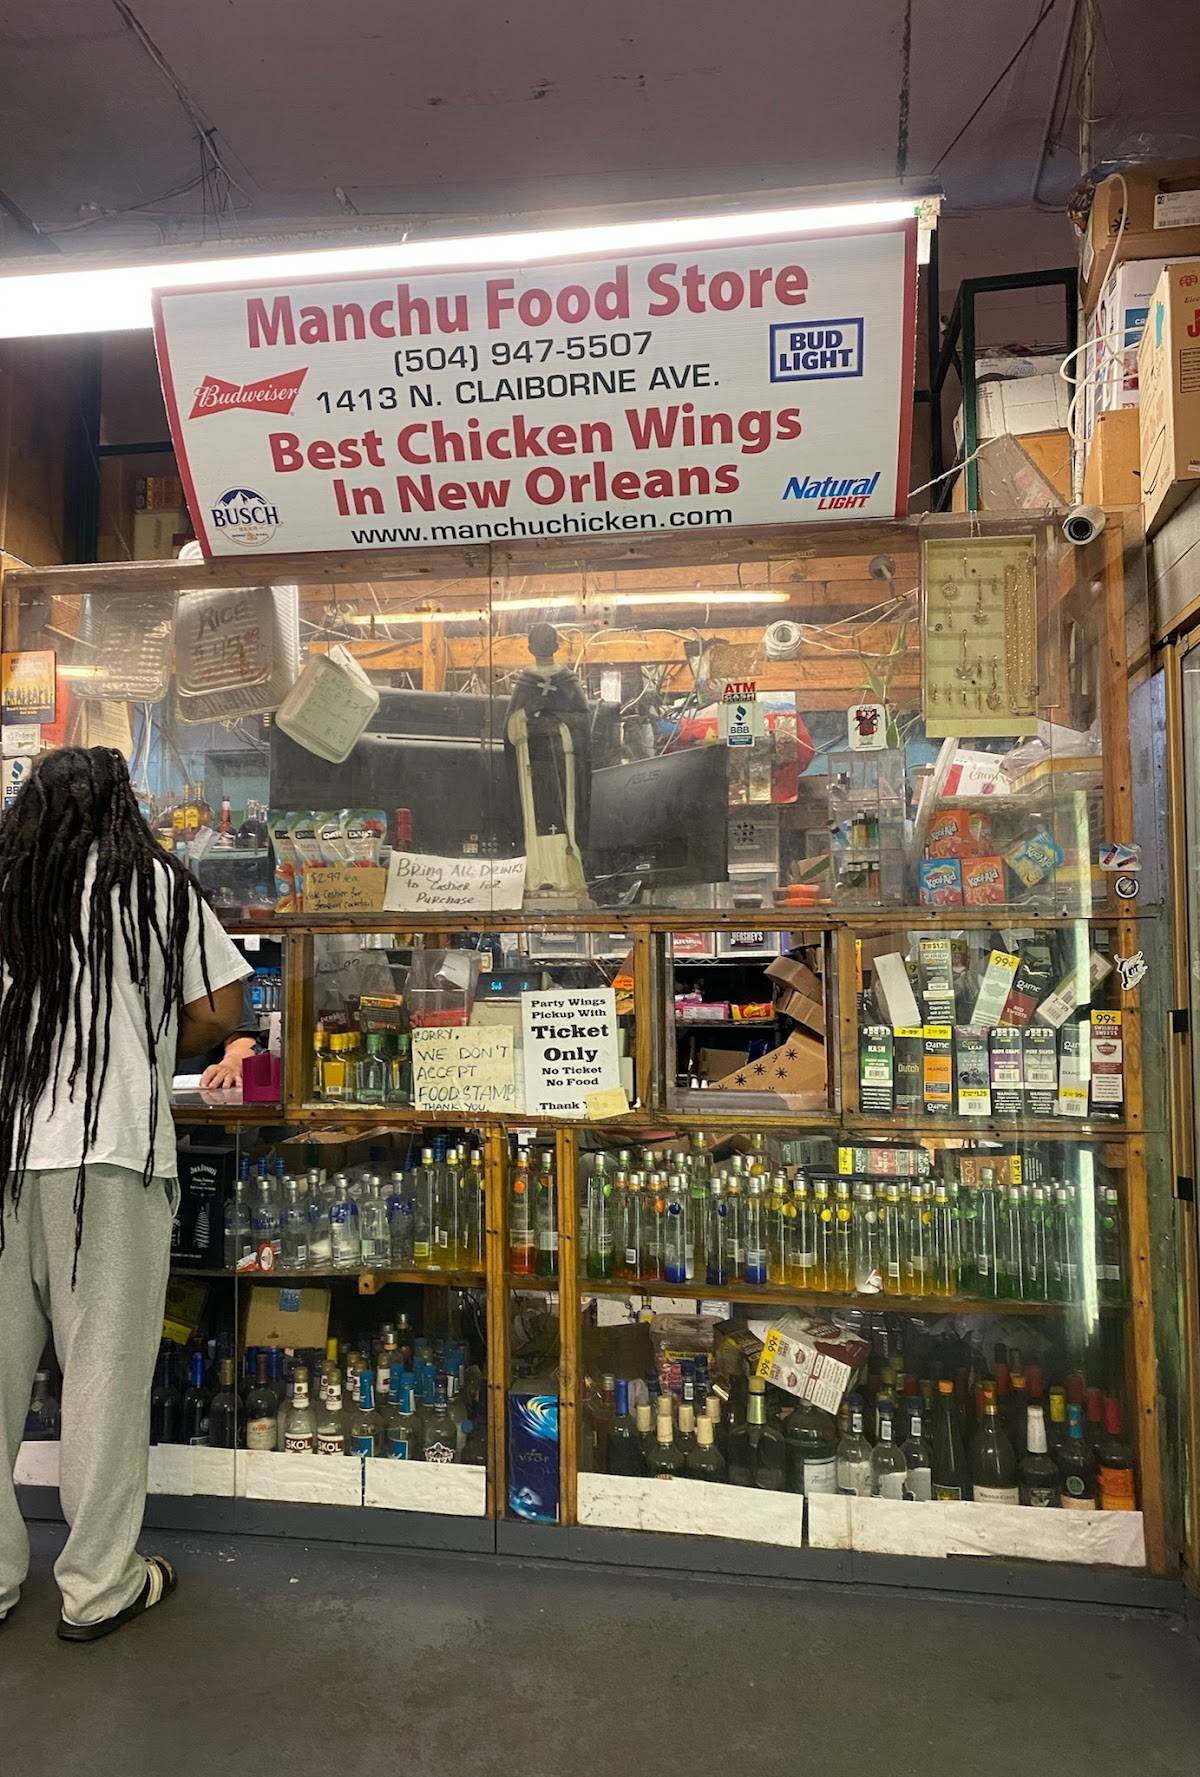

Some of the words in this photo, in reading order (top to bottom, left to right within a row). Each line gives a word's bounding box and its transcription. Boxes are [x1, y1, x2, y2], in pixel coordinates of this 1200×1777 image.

[247, 284, 469, 348] Manchu
[486, 265, 630, 330] Food
[647, 263, 809, 317] Store
[789, 329, 844, 351] BUD
[394, 344, 479, 376] (504)
[491, 331, 653, 366] 947-5507
[779, 347, 853, 372] LIGHT
[193, 383, 302, 409] Budweiser
[317, 386, 398, 414] 1413
[409, 384, 442, 408] N.
[456, 369, 636, 404] CLAIBORNE
[648, 363, 720, 391] AVE.
[269, 430, 386, 473] Best
[397, 414, 613, 466] Chicken
[624, 402, 802, 454] Wings
[332, 479, 384, 516] In
[396, 474, 511, 513] New
[525, 461, 740, 505] Orleans
[782, 471, 881, 500] Natural
[816, 495, 870, 510] LIGHT
[211, 506, 280, 527] BUSCH
[351, 506, 733, 543] www.manchuchicken.com
[725, 682, 756, 693] ATM
[730, 726, 750, 734] BBB
[6, 786, 23, 795] BB
[926, 871, 957, 889] Kool-Aid
[968, 867, 999, 888] Kool-Aid
[994, 955, 1015, 968] 99¢
[1016, 979, 1042, 993] game
[531, 1000, 565, 1008] Party
[568, 998, 606, 1006] Wings
[531, 1011, 575, 1019] Pickup
[578, 1009, 607, 1017] With
[1095, 1013, 1116, 1024] 99¢
[531, 1024, 609, 1039] Ticket
[417, 1048, 448, 1061] WE
[459, 1044, 510, 1060] DON'T
[925, 1040, 950, 1052] game
[544, 1047, 598, 1063] Only
[416, 1065, 478, 1081] ACCEPT
[542, 1067, 559, 1075] No
[562, 1066, 602, 1074] Ticket
[898, 1063, 920, 1073] Dutch
[546, 1079, 563, 1087] No
[567, 1078, 599, 1086] Food
[422, 1102, 459, 1112] THANK
[540, 1101, 580, 1110] Thank
[964, 1159, 976, 1184] 504
[767, 1335, 779, 1353] 99¢
[760, 1358, 770, 1377] 99¢
[285, 1438, 311, 1450] SKOL
[317, 1440, 342, 1452] SKOL
